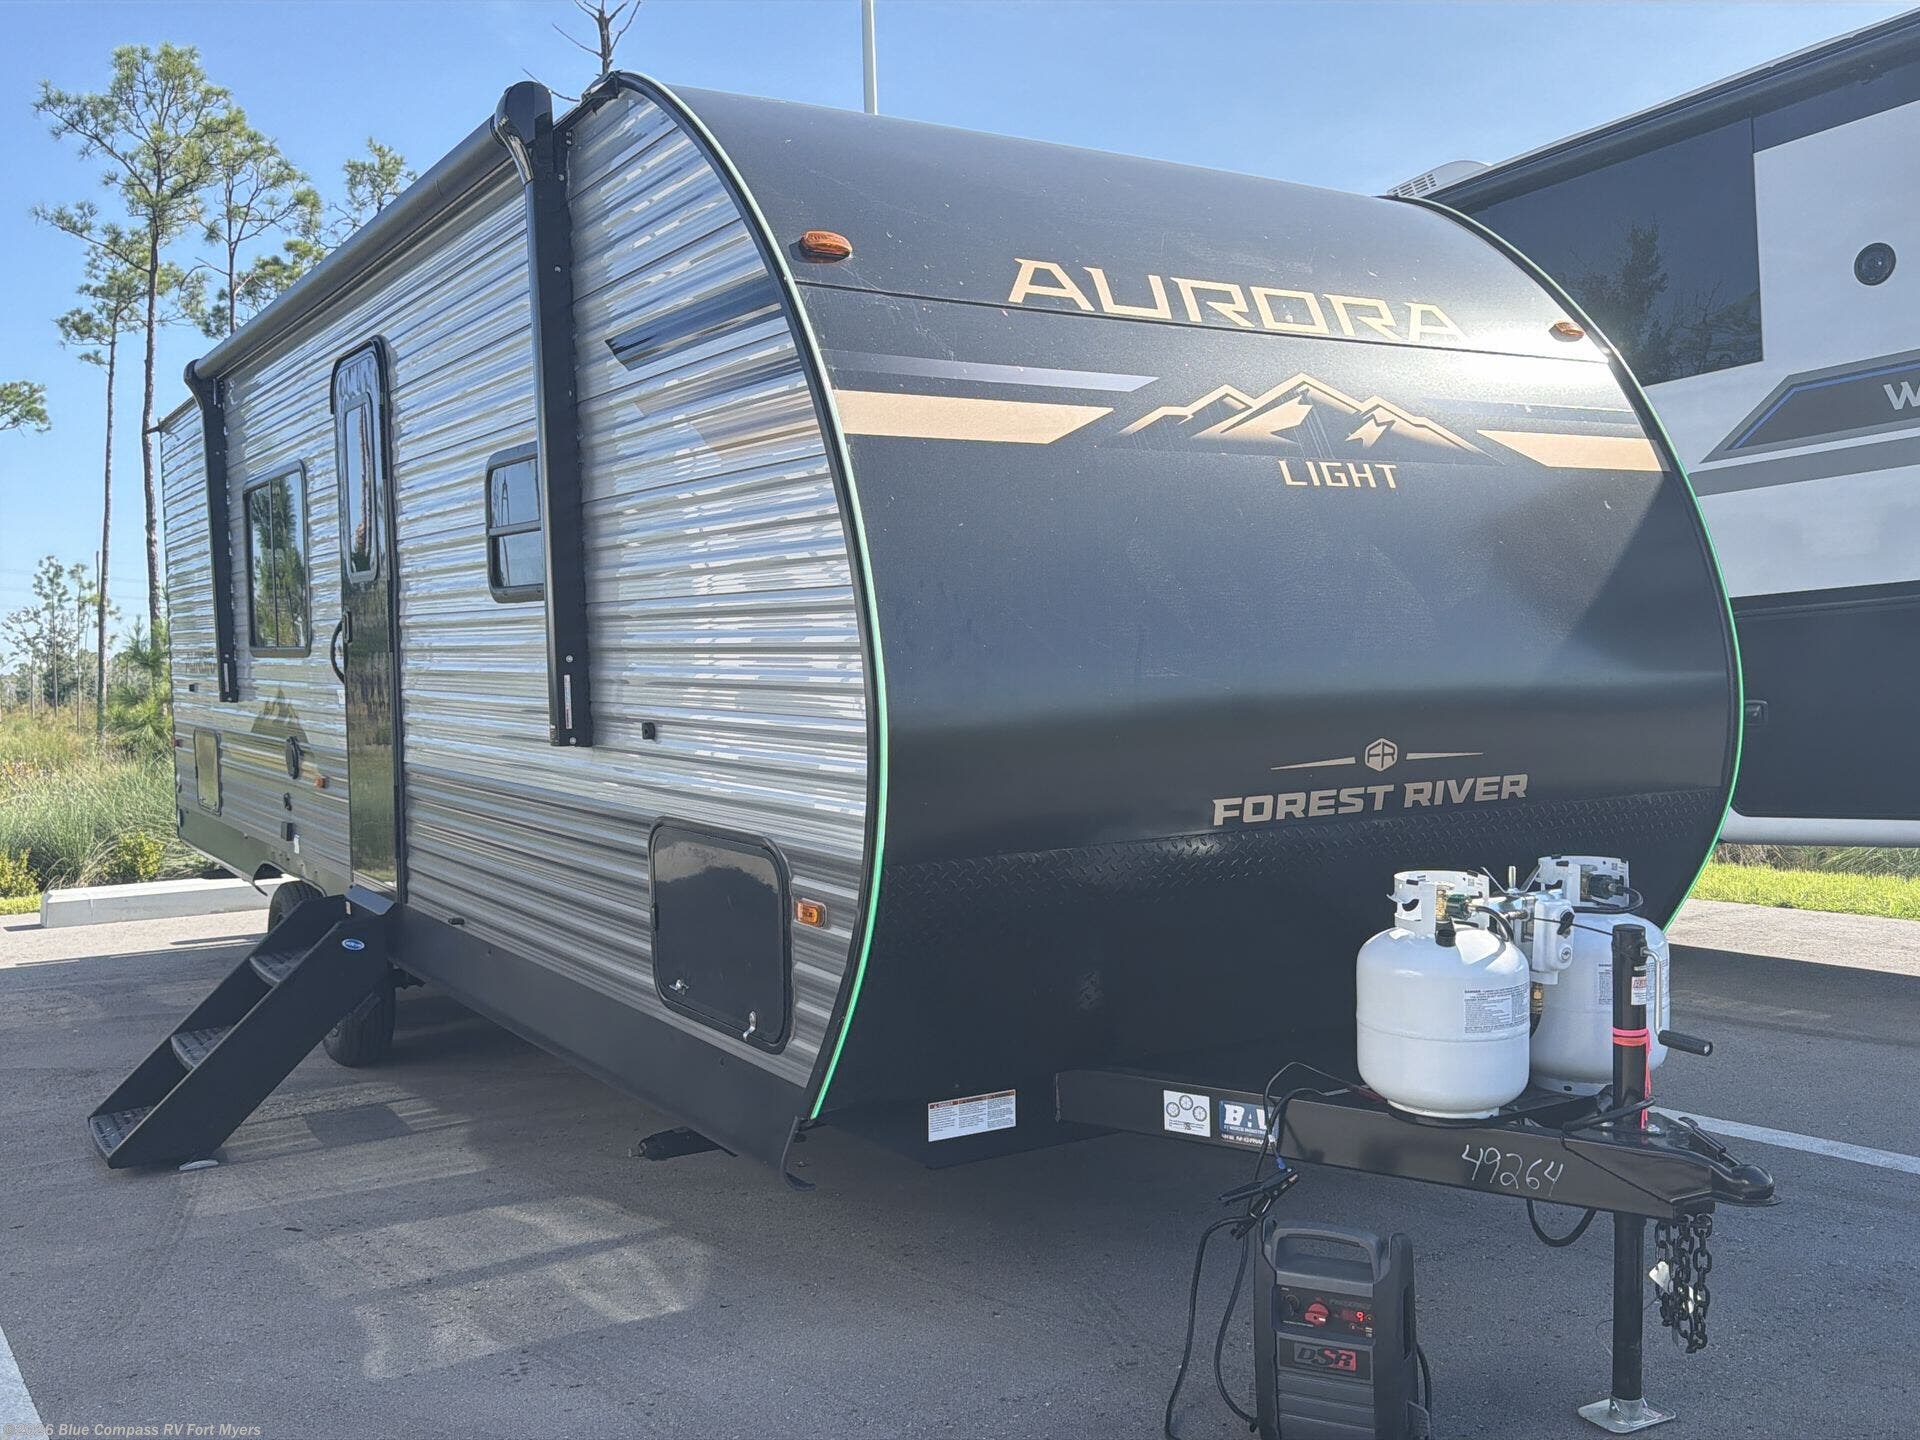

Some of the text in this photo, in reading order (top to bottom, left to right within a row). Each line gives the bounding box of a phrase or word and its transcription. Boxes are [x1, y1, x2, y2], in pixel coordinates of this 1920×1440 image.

[1008, 258, 1469, 342] AURORA
[1278, 460, 1397, 489] LIGHT
[1212, 774, 1528, 826] FOREST RIVER
[1461, 1144, 1564, 1196] 49264
